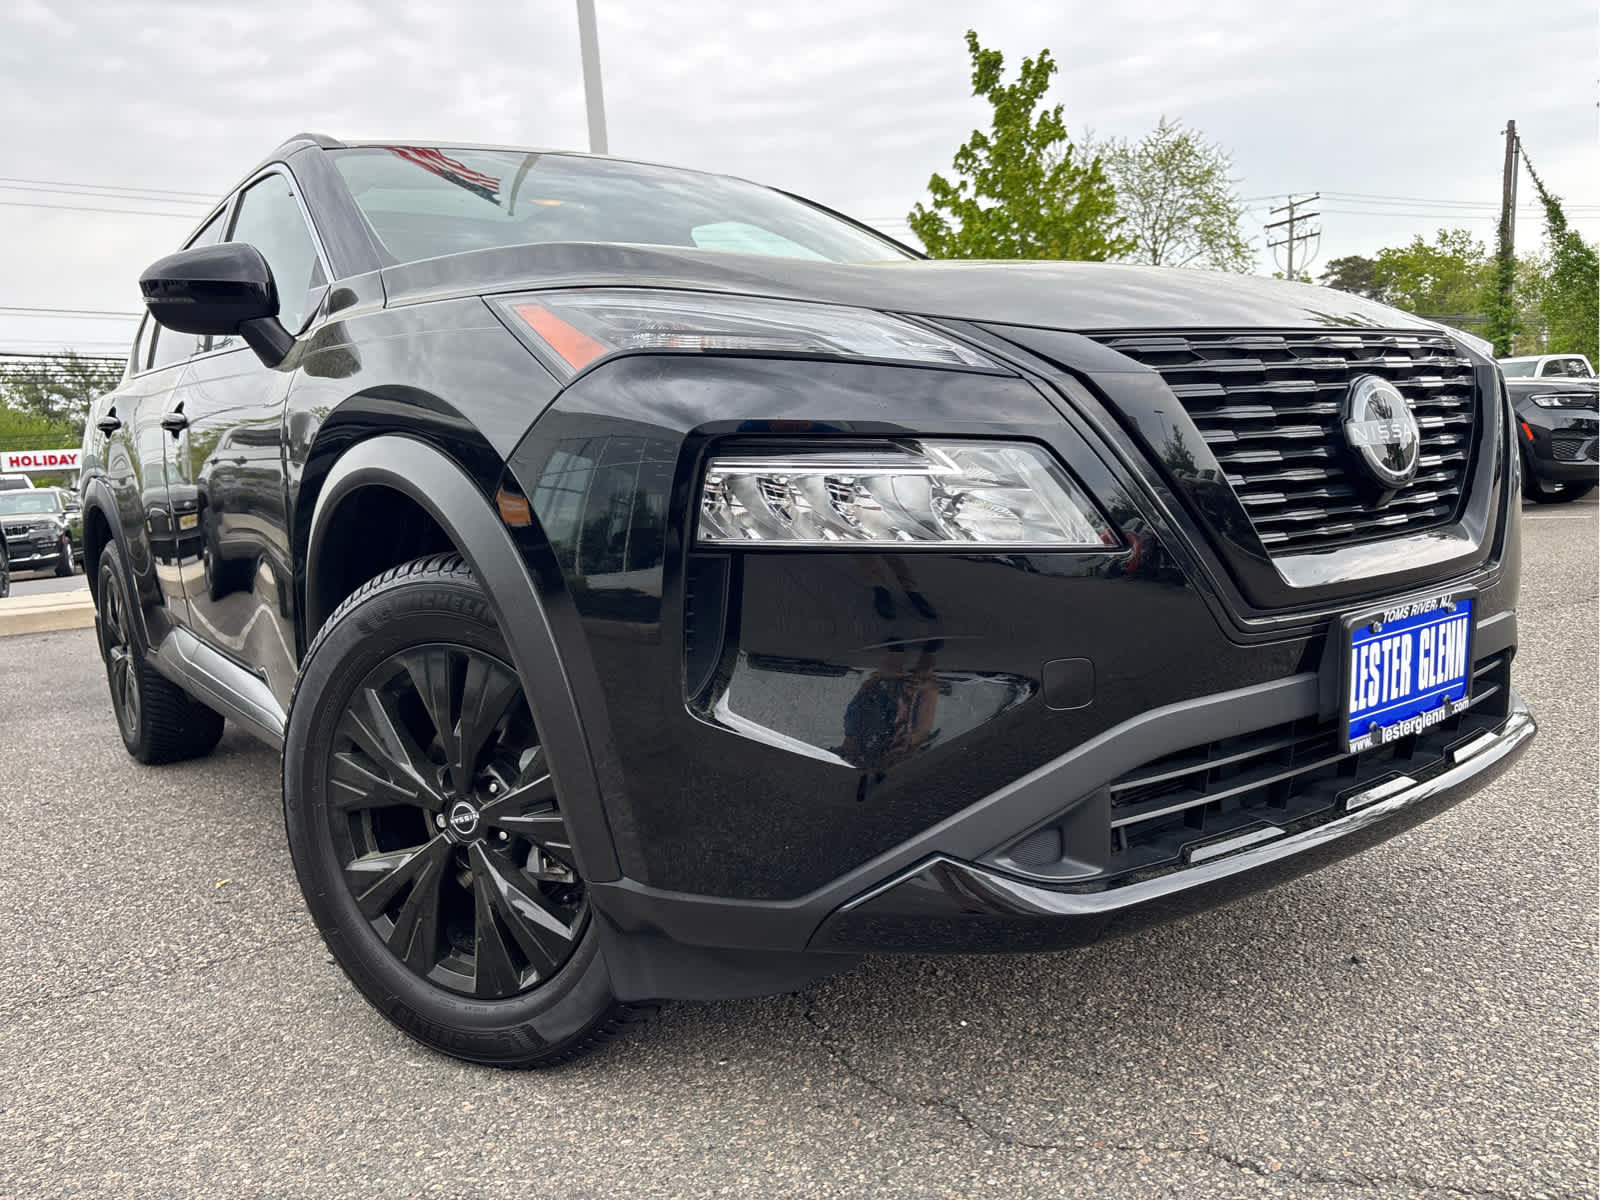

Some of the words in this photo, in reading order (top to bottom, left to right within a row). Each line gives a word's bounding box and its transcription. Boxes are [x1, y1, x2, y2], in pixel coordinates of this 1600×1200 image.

[8, 454, 77, 467] HOLIDAY
[1383, 606, 1408, 623] TOMS
[1349, 633, 1412, 714] LESTER
[1418, 617, 1468, 691] GLENN
